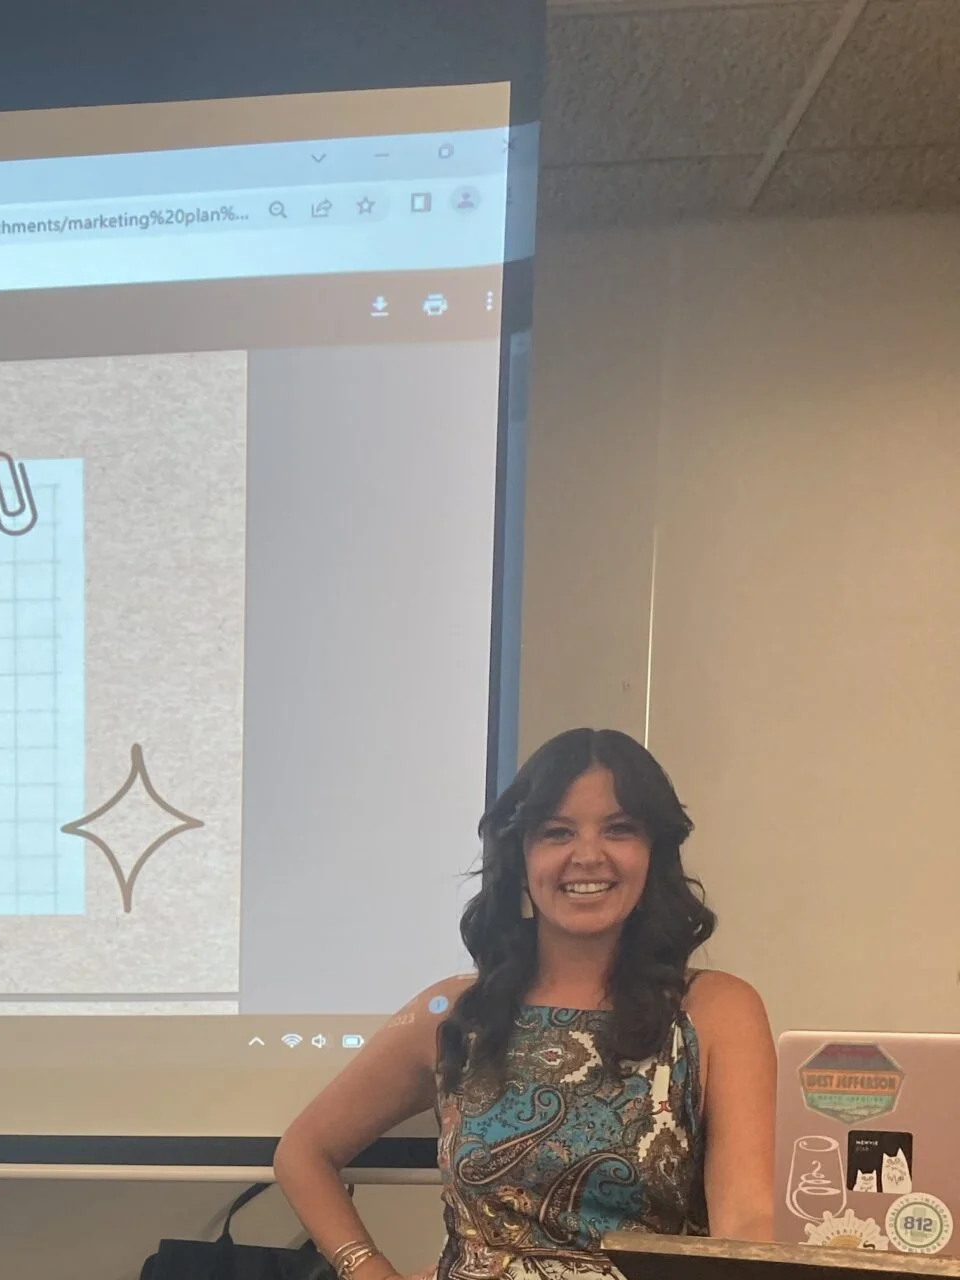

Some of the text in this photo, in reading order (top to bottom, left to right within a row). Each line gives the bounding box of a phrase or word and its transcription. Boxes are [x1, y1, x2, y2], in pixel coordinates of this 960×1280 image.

[805, 1074, 897, 1090] WEST JEFFERSON
[903, 1215, 933, 1232] 812
